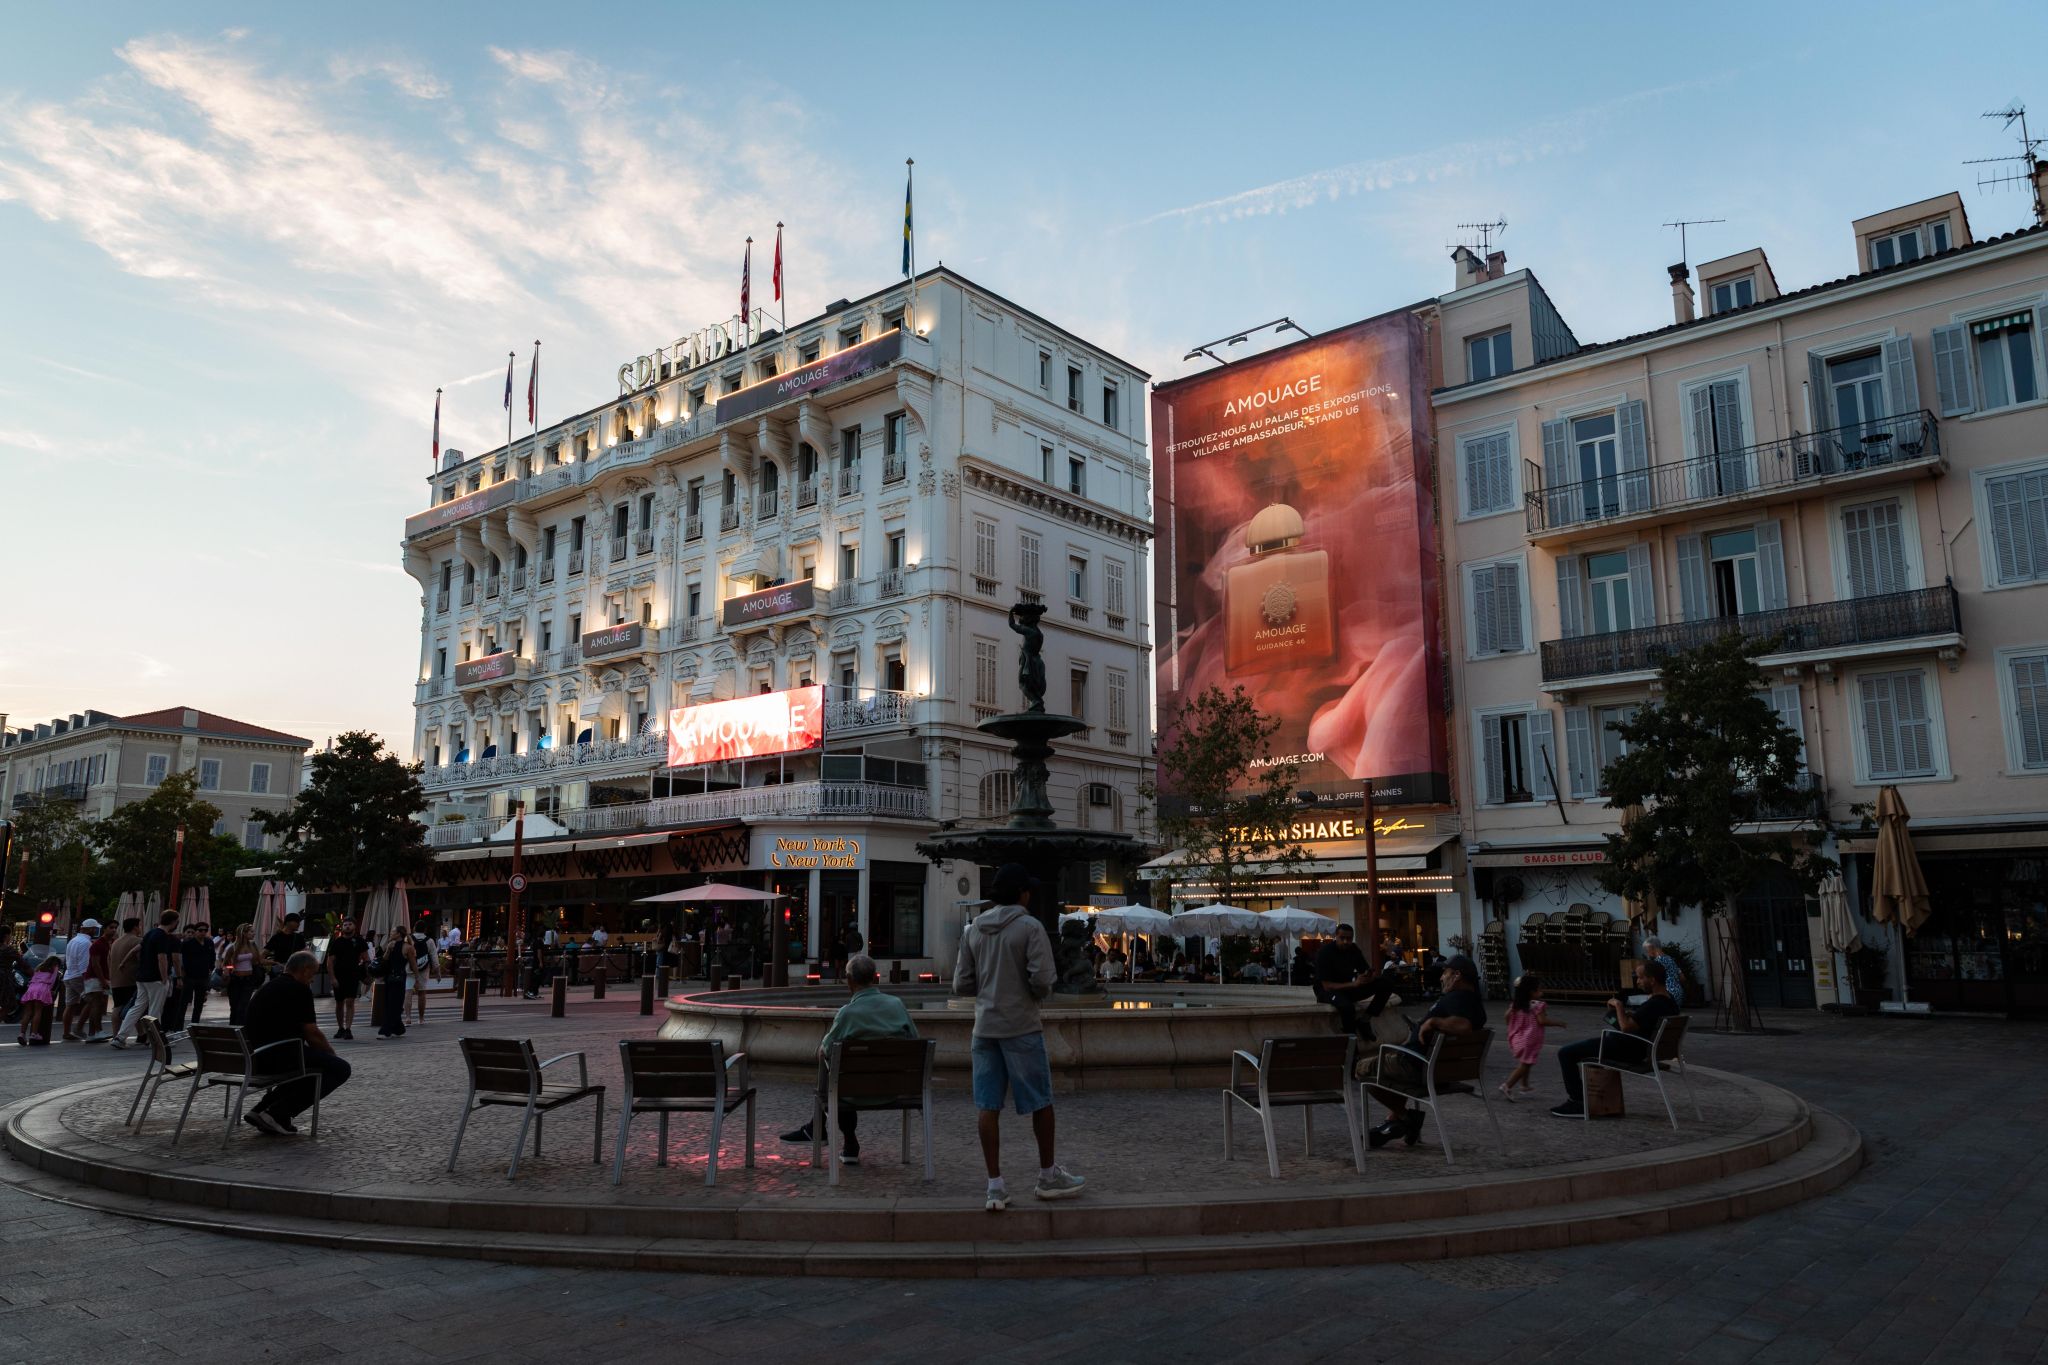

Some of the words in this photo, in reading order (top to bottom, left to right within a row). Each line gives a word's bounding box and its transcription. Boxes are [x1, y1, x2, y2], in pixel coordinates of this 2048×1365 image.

[617, 310, 760, 396] SPLENDID
[777, 365, 829, 394] AMOUAGE
[1224, 375, 1321, 418] AMOUAGE
[1166, 424, 1247, 455] RETROUVEZ-NOUS
[1248, 420, 1263, 432] AU
[1265, 409, 1299, 427] PALAIS
[1301, 404, 1320, 417] DES
[1323, 383, 1392, 410] EXPOSITIONS
[1192, 440, 1231, 459] VILLAGE
[1232, 420, 1307, 448] AMBASSADEUR,
[1308, 410, 1342, 426] STAND
[1345, 405, 1359, 417] U6
[442, 500, 473, 518] AMOUAGE
[742, 592, 792, 614] AMOUAGE
[590, 630, 631, 649] AMOUAGE
[1255, 624, 1306, 640] AMOUAGE
[1256, 639, 1294, 651] GUIDANCE
[467, 660, 500, 677] AMOUAGE
[1291, 820, 1355, 840] SHAKE
[1355, 827, 1364, 835] BY
[776, 837, 808, 852] New
[813, 836, 846, 852] York
[785, 853, 818, 867] New
[822, 853, 856, 868] York
[1523, 854, 1566, 864] SMASH
[1571, 852, 1603, 861] CLUB
